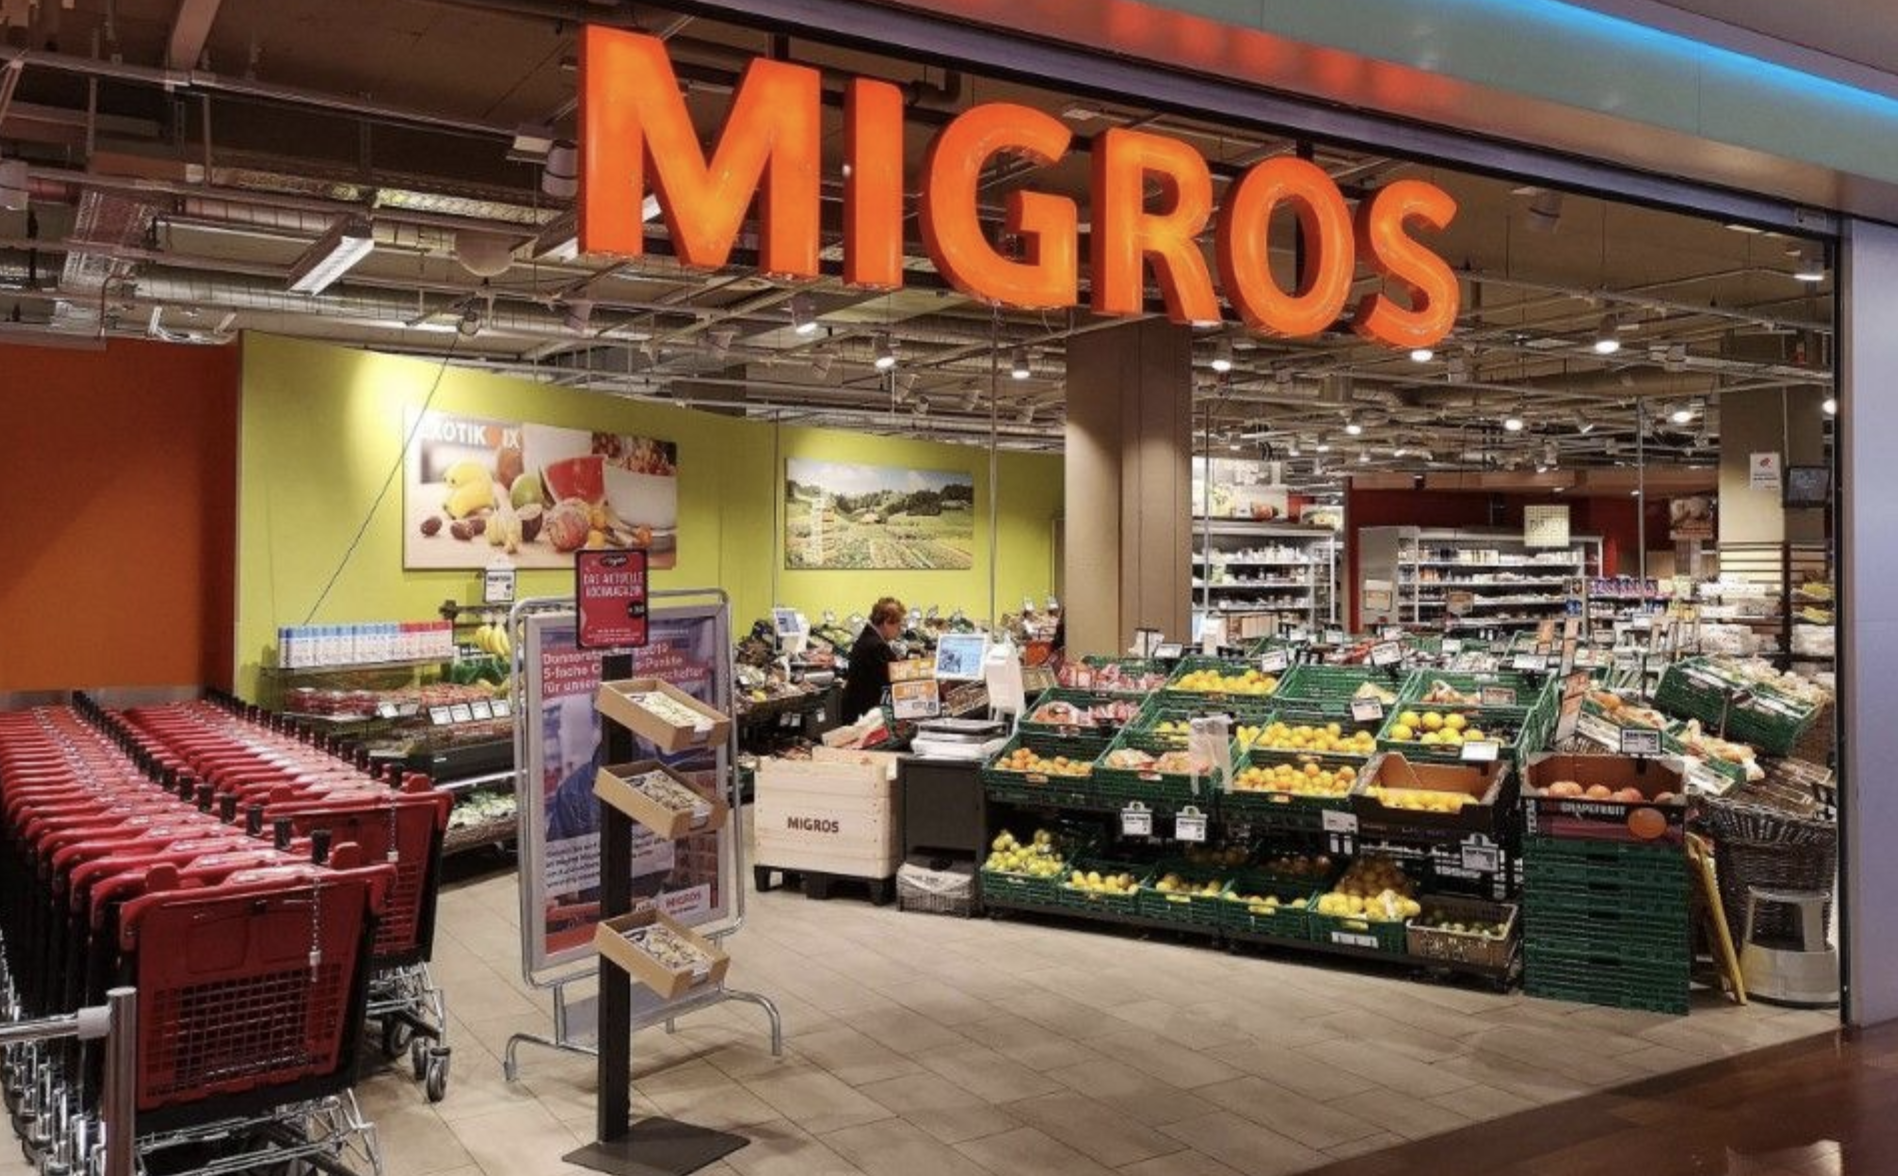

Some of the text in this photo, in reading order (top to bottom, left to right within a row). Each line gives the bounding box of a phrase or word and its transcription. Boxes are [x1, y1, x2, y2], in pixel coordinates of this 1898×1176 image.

[578, 24, 1459, 348] MIGROS
[543, 666, 589, 680] 5-fache
[544, 681, 561, 694] für
[1560, 801, 1627, 816] GRAPEFRUIT
[787, 816, 840, 833] MIGROS
